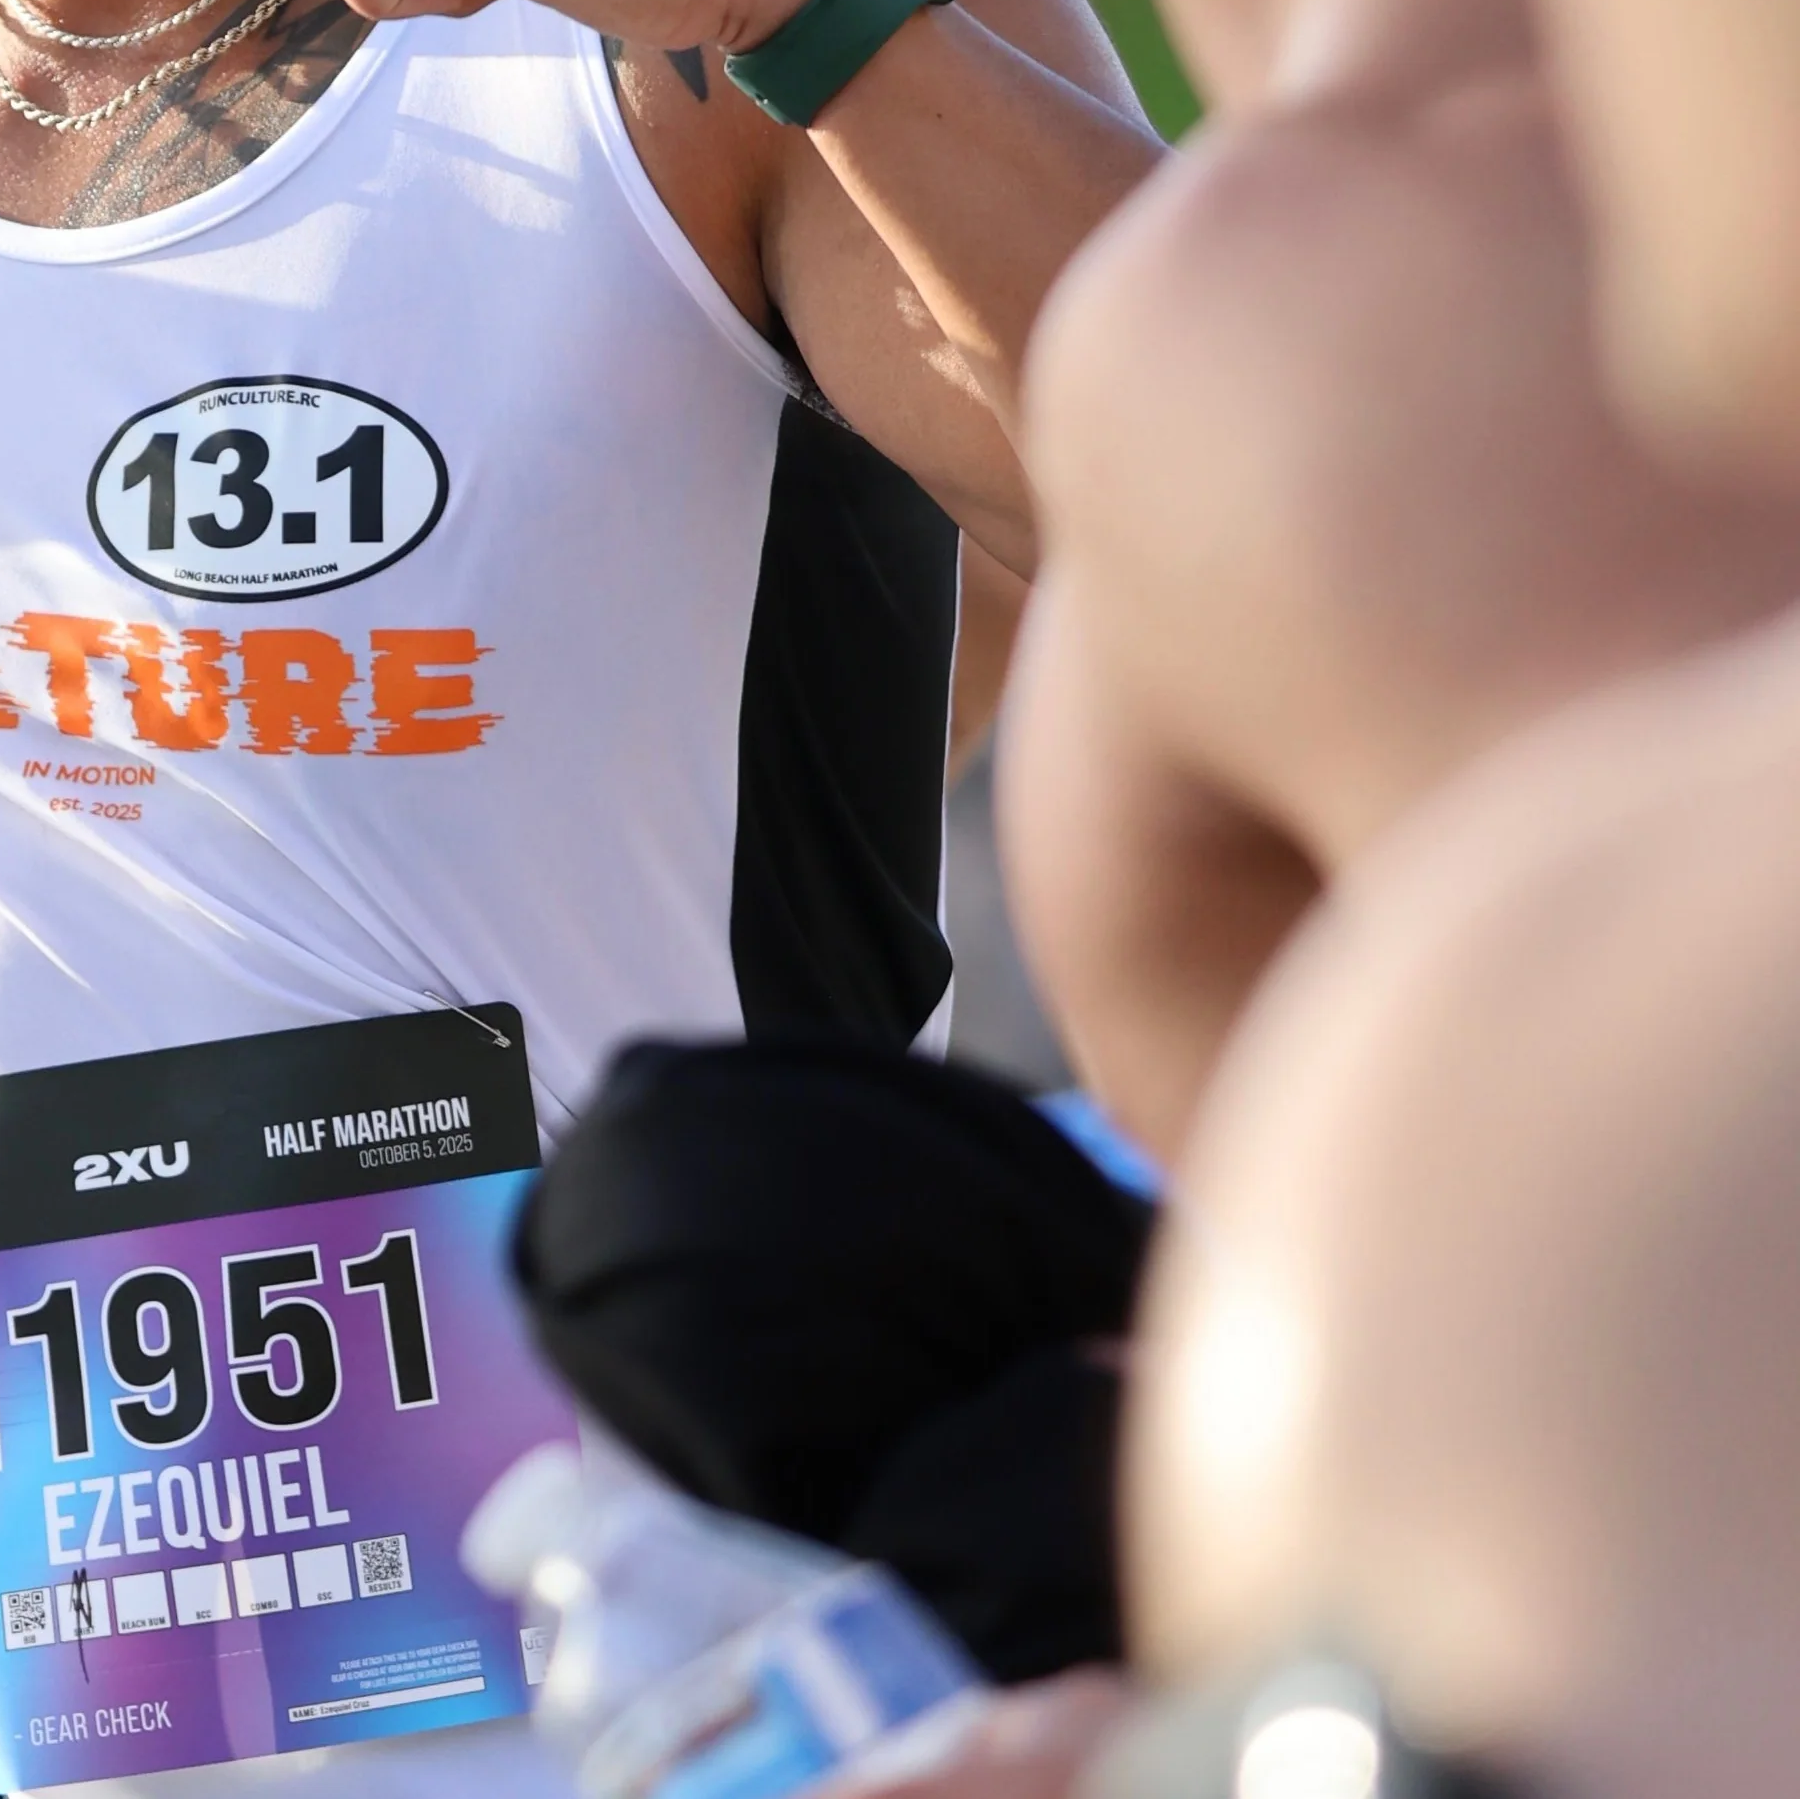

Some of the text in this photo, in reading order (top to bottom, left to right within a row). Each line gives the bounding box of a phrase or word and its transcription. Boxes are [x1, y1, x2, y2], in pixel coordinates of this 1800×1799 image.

[200, 390, 320, 414] RUNCULTURE.RC
[122, 425, 384, 550] 13.1
[174, 562, 338, 584] LONG BEACH HALF MARATHON
[22, 760, 155, 786] IN MOTION
[50, 797, 142, 821] est. 2025
[264, 1096, 471, 1158] HALF MARATHON
[359, 1140, 420, 1168] OCTOBER
[437, 1132, 473, 1157] 2025
[73, 1140, 190, 1192] 2XU
[43, 1445, 350, 1566] EZEQUIEL
[368, 1581, 402, 1593] RESULTS
[250, 1600, 279, 1612] COMBO
[121, 1616, 166, 1630] BEACH BUM
[29, 1712, 88, 1746] GEAR
[95, 1701, 172, 1738] CHECK
[292, 1708, 317, 1719] NAME:
